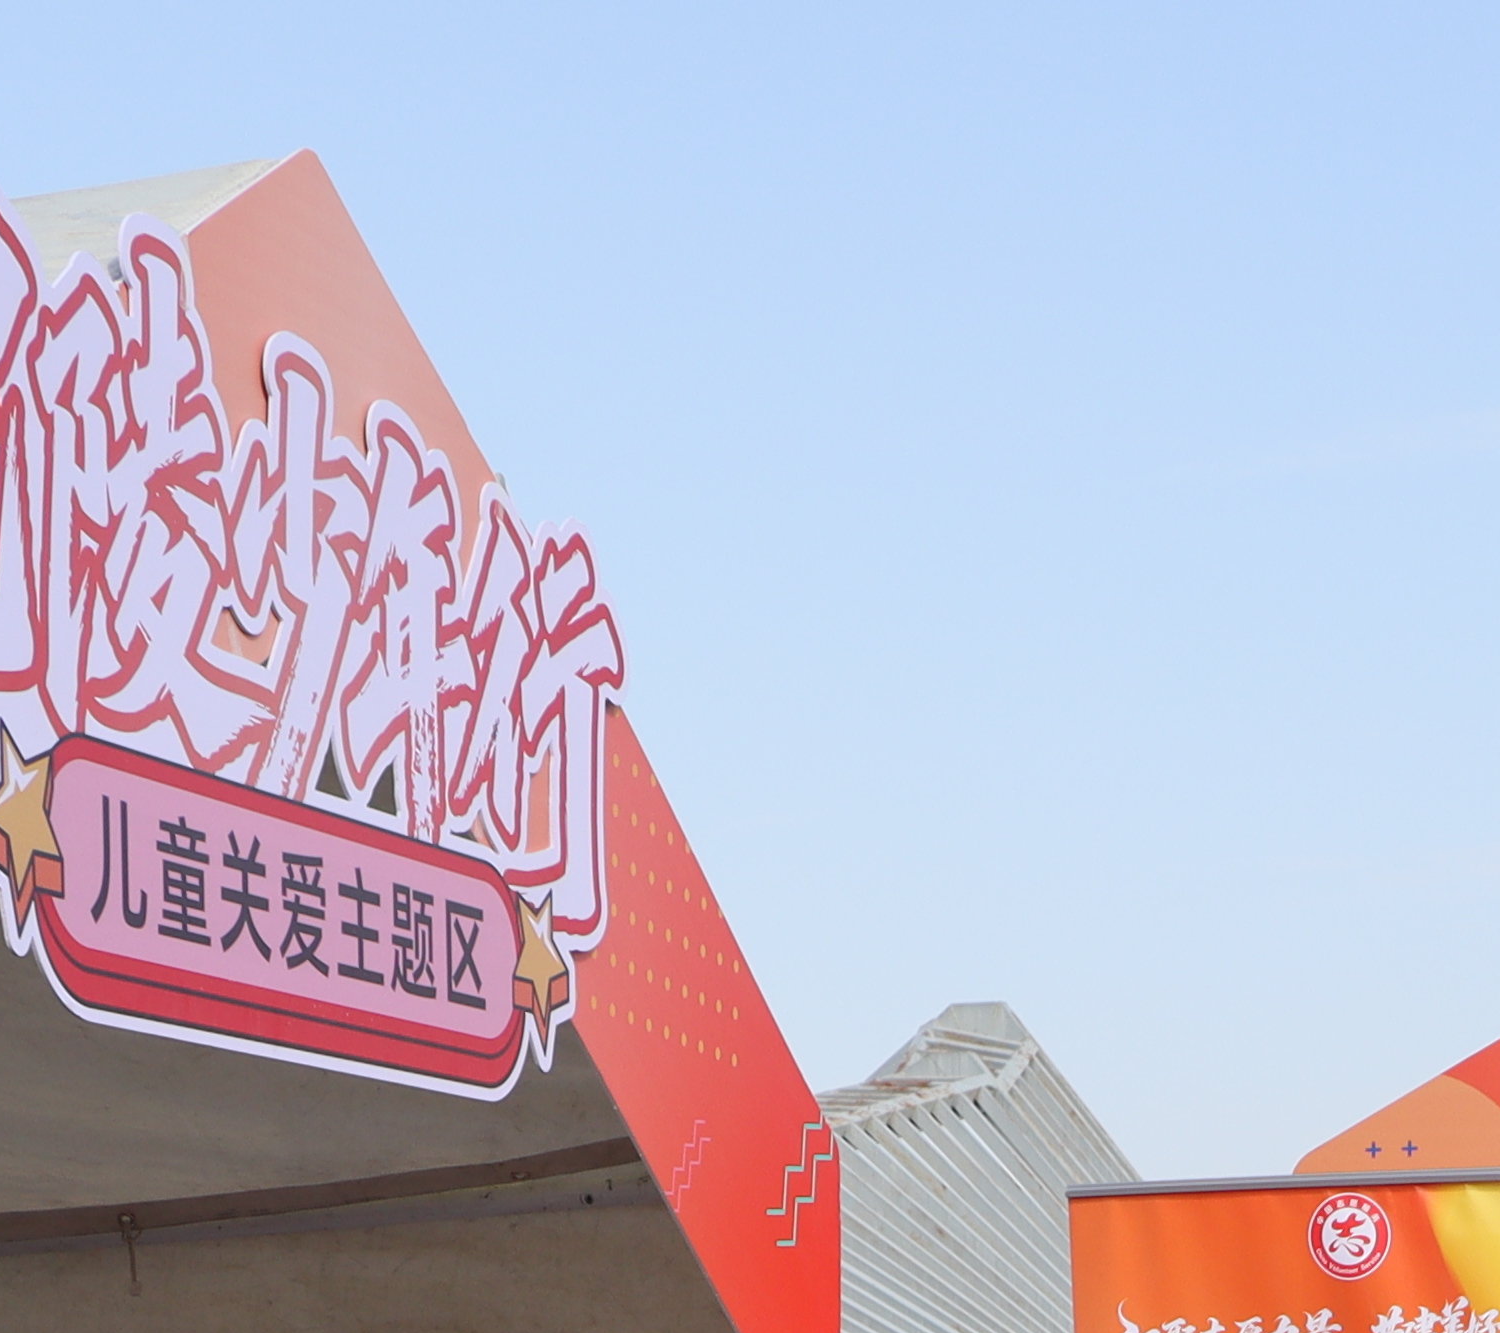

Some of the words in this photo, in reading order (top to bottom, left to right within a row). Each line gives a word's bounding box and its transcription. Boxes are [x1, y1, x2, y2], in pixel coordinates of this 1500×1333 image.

[90, 794, 487, 1011] 儿童关爱主题区
